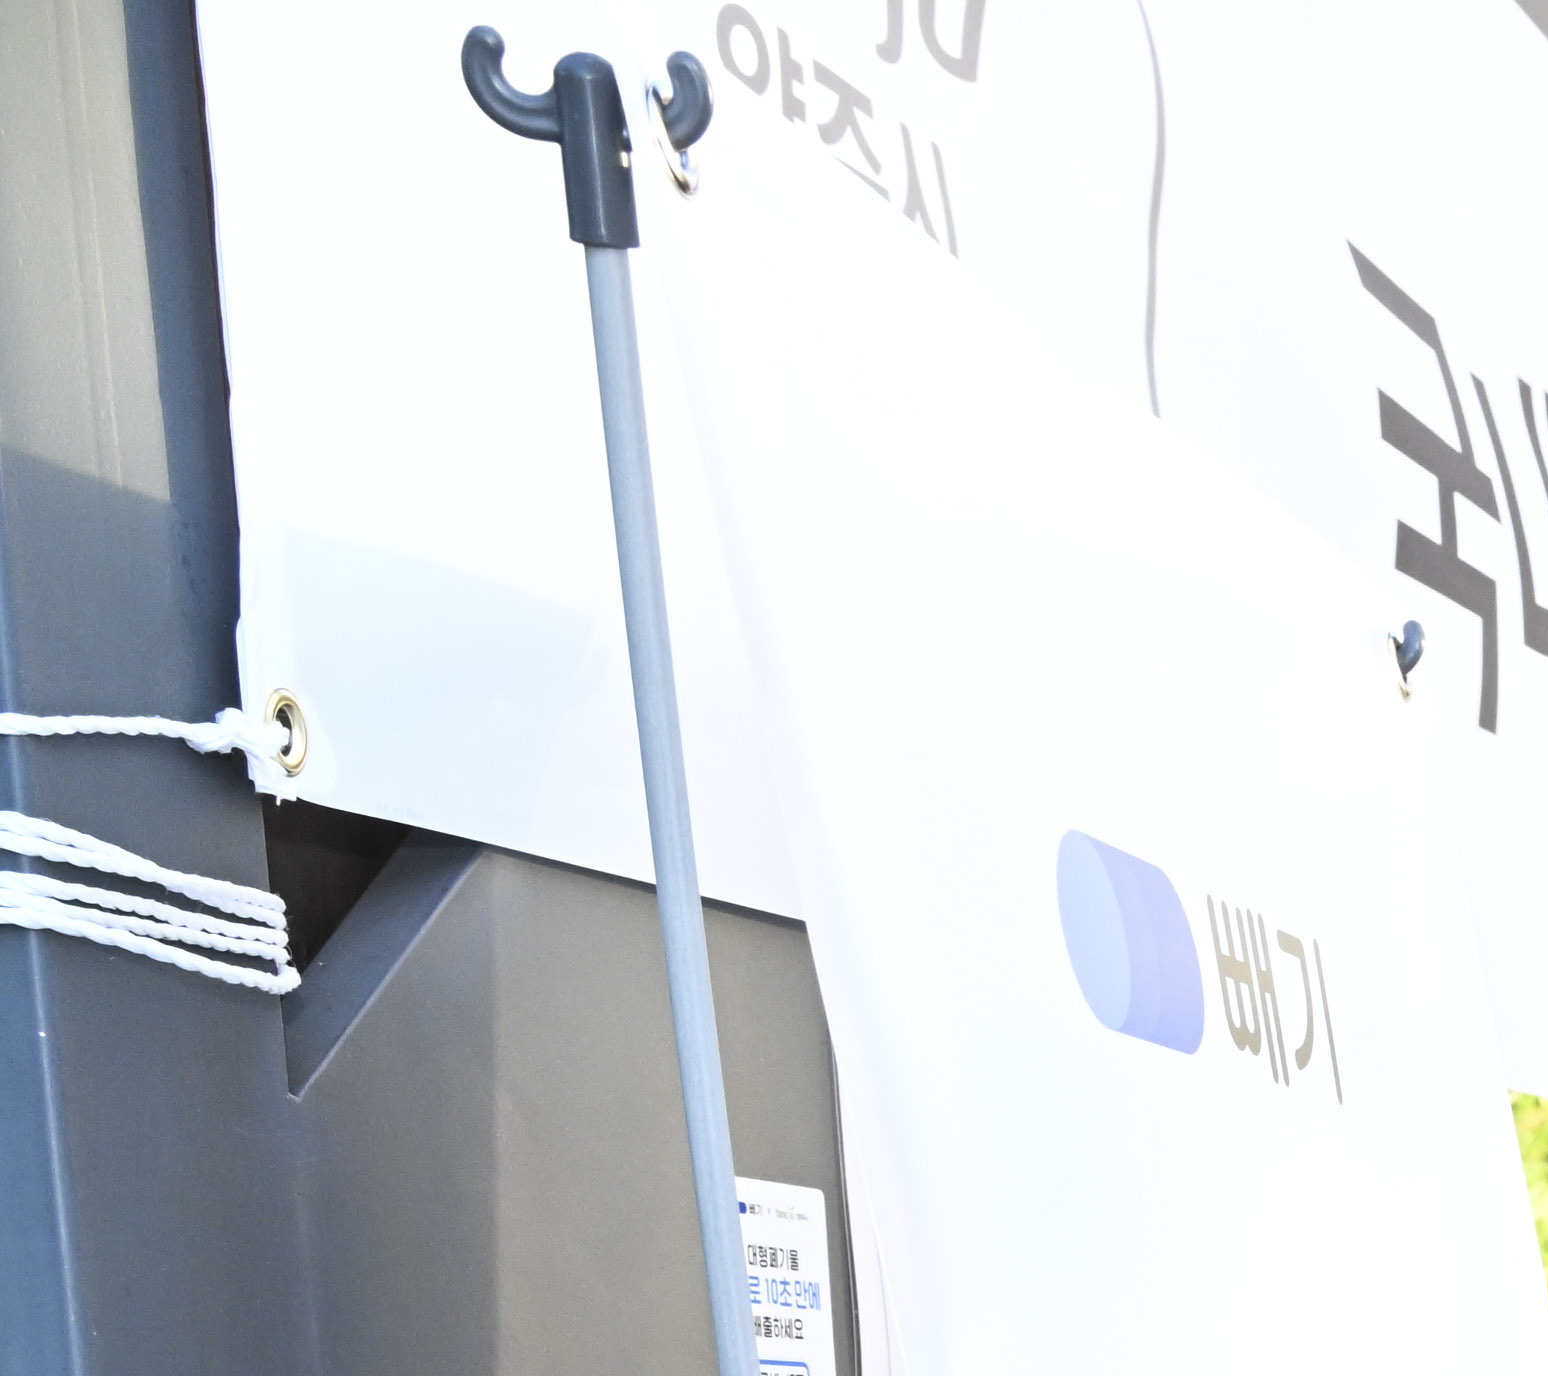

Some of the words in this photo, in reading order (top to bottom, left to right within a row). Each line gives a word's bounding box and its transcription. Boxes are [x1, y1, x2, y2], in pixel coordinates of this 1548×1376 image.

[1207, 893, 1342, 1105] 빼기
[747, 1244, 799, 1271] 대형폐기물
[765, 1277, 793, 1308] 10초
[795, 1279, 821, 1311] 만에
